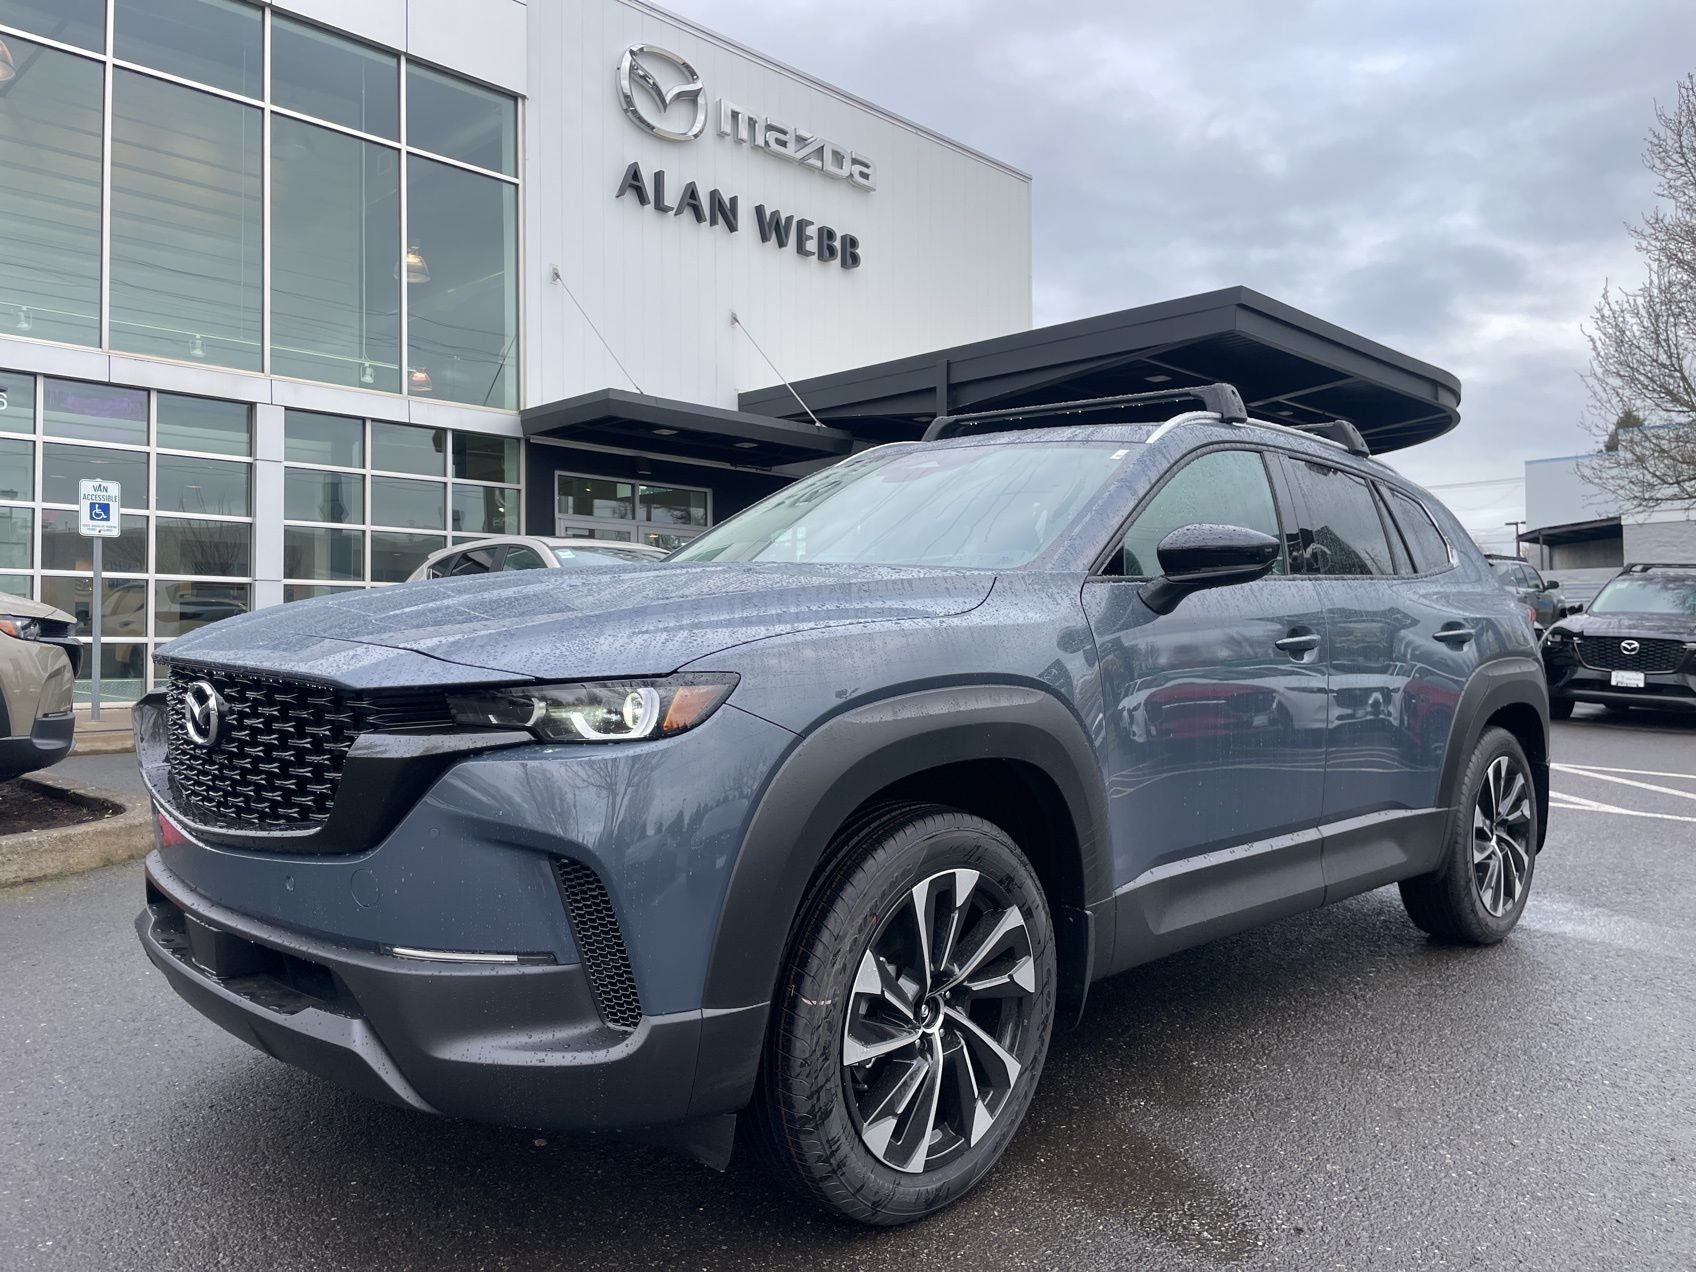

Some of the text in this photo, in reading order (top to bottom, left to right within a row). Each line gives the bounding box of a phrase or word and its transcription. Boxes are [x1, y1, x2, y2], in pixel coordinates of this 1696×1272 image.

[716, 97, 877, 192] mazda
[615, 161, 861, 269] ALAN WEBB
[82, 493, 118, 502] ACCESSIBLE
[92, 484, 108, 493] VAN
